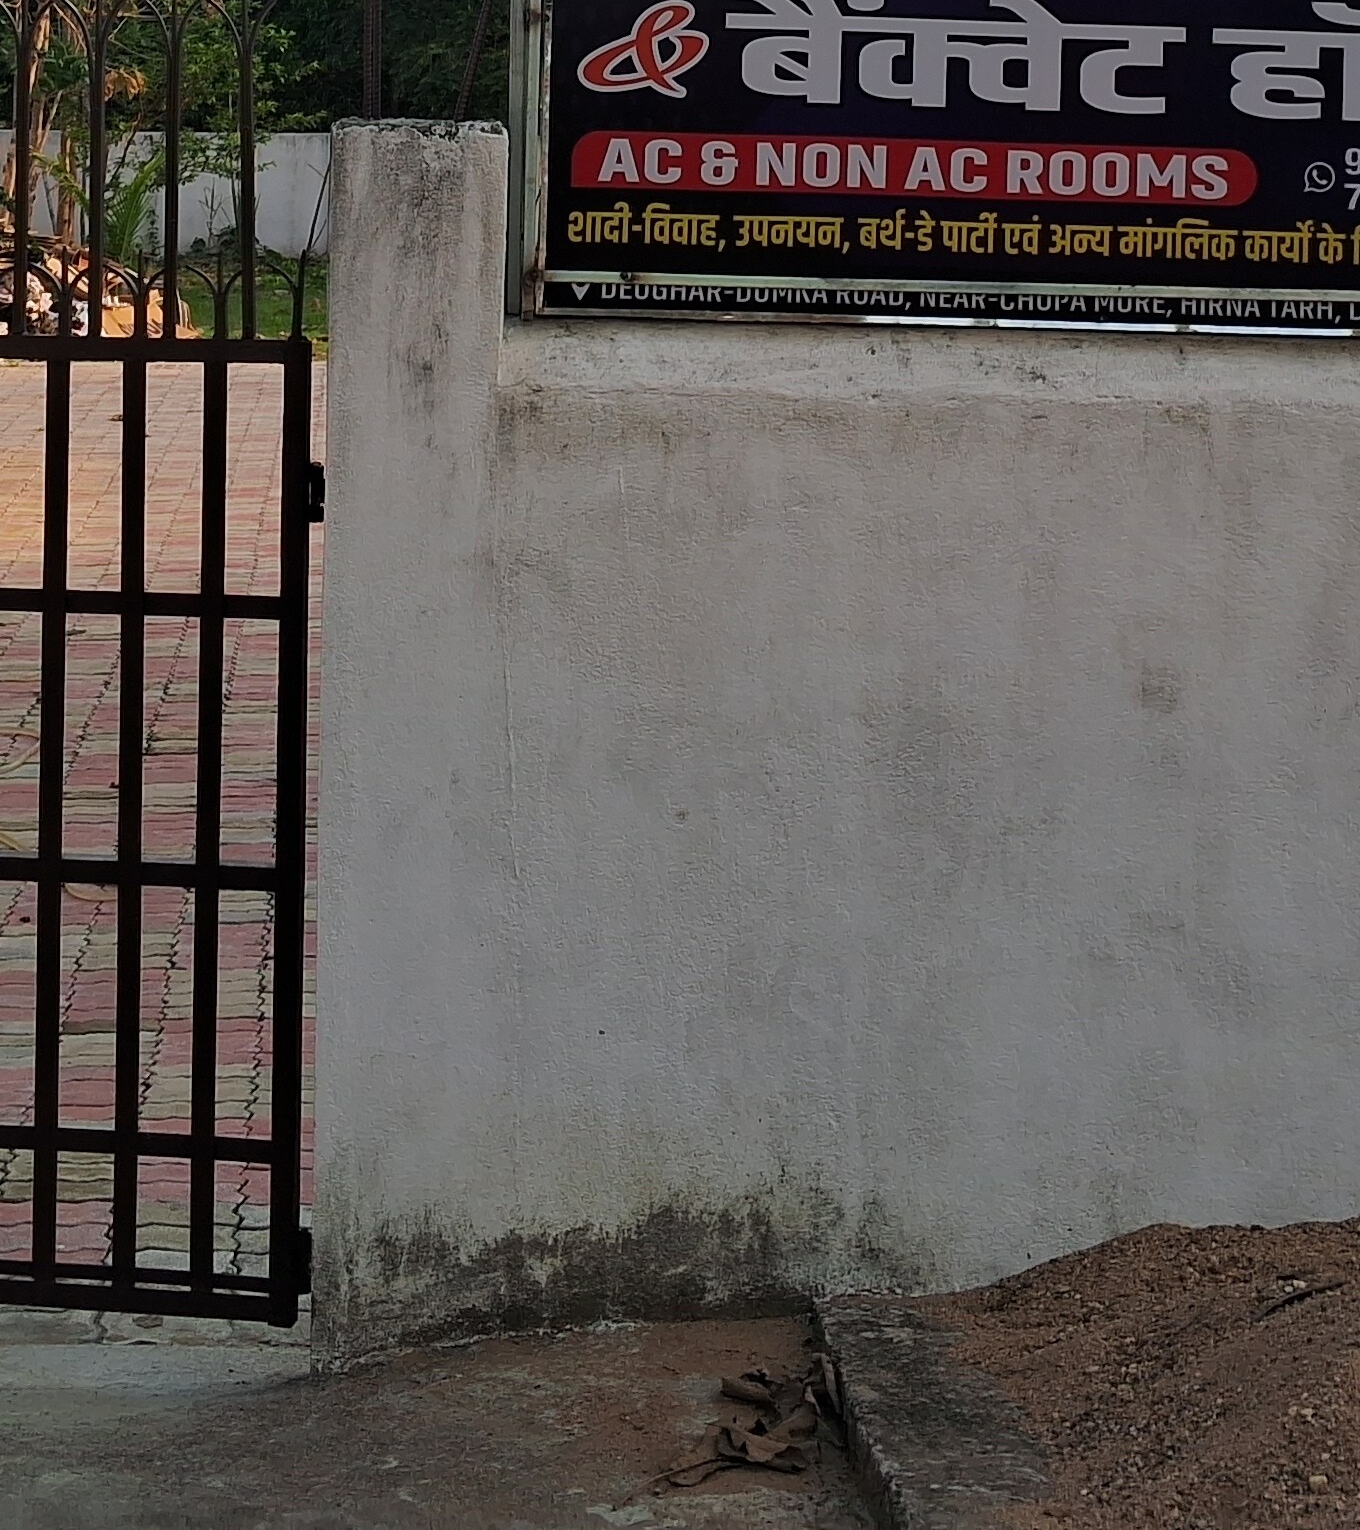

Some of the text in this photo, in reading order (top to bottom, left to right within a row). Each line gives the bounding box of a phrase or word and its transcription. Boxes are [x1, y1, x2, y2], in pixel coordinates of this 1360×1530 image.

[596, 137, 1230, 200] AC & NON AC ROOMS
[567, 202, 726, 252] शादी-विवाह,
[733, 214, 851, 255] उपनयन,
[858, 208, 936, 252] बर्थ-डे
[940, 212, 997, 255] पार्टी
[1001, 214, 1042, 256] एवं
[1048, 222, 1114, 257] अन्य
[1117, 217, 1239, 261] मांगलिक
[1242, 220, 1316, 264] कार्यों
[1316, 222, 1347, 265] के
